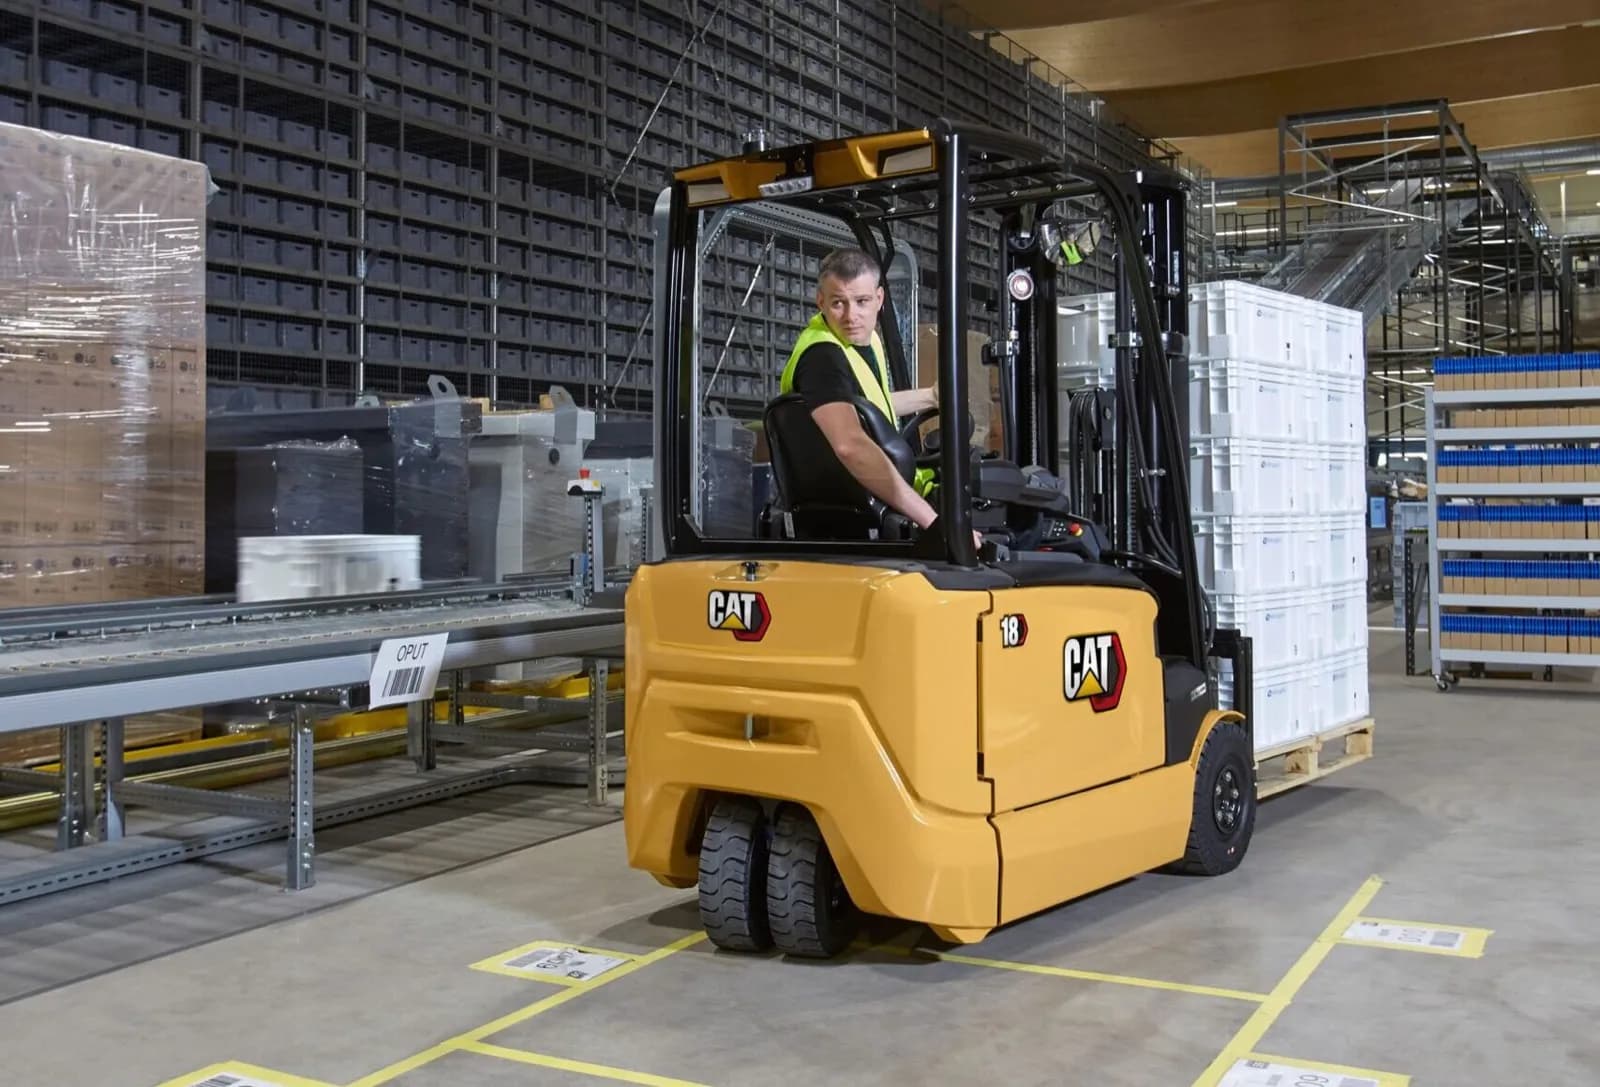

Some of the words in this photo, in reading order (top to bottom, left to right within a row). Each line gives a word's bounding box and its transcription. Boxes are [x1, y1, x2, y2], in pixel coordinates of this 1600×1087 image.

[709, 590, 756, 631] CAT
[1000, 615, 1019, 647] 18
[396, 642, 429, 662] OPUT
[1064, 634, 1113, 700] CAT
